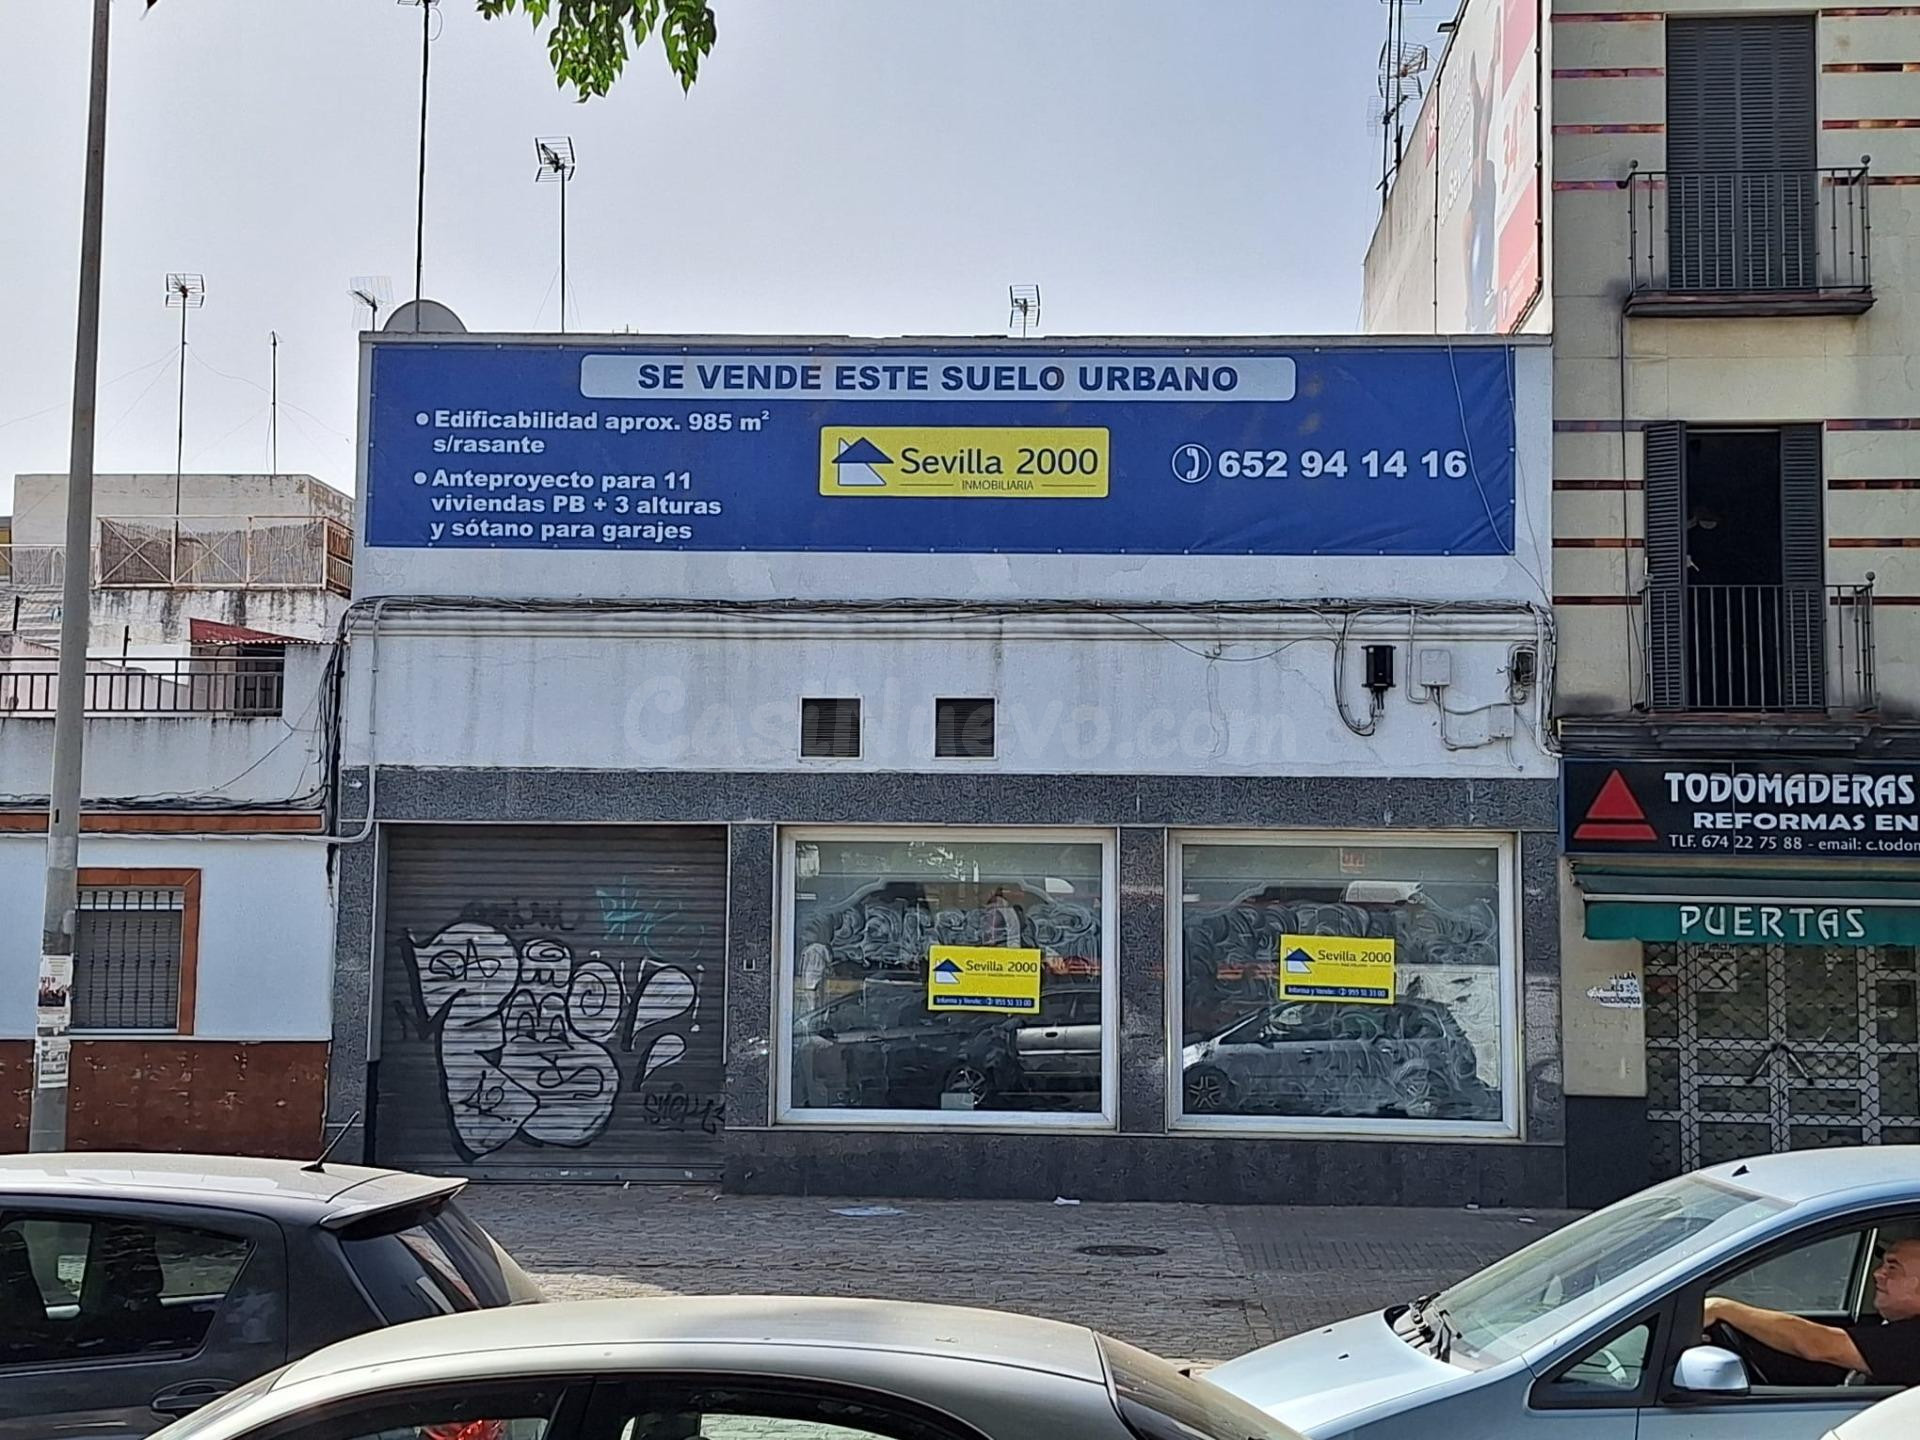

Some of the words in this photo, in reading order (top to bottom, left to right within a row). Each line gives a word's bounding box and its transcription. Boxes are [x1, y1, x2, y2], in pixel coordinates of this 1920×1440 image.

[638, 364, 684, 390] SE
[696, 364, 822, 390] VENDE
[835, 365, 929, 391] ESTE
[940, 365, 1065, 391] SUELO
[1079, 366, 1238, 392] URBANO
[434, 410, 598, 429] Edificabilidad
[605, 416, 681, 434] aprox.
[688, 413, 732, 431] 985
[433, 434, 545, 454] s/rasante
[900, 447, 1004, 475] Sevilla
[1016, 448, 1098, 475] 2000
[1218, 450, 1288, 478] 652
[1301, 450, 1348, 478] 94
[1361, 450, 1408, 478] 14
[1421, 450, 1467, 478] 16
[431, 469, 594, 492] Anteproyecto
[601, 475, 656, 493] para
[664, 471, 690, 490] 11
[961, 479, 1034, 491] INMOBILIARIA
[431, 493, 545, 513] viviendas
[553, 495, 586, 513] PB
[593, 497, 607, 511] +
[614, 495, 629, 514] 3
[636, 496, 722, 515] alturas
[430, 522, 444, 540] y
[451, 518, 534, 537] sótano
[541, 524, 595, 542] para
[602, 521, 692, 543] garajes
[1664, 772, 1915, 808] TODOMADERAS
[1694, 812, 1866, 831] REFORMAS
[1875, 814, 1919, 831] EN
[1668, 834, 1697, 848] TLF.
[1702, 835, 1729, 848] 674
[1735, 835, 1754, 849] 22
[1760, 836, 1777, 849] 75
[1783, 836, 1803, 850] 88
[1818, 838, 1862, 851] email:
[1679, 905, 1866, 940] PUERTAS
[966, 960, 1003, 971] Sevilla
[1007, 962, 1037, 973] 2000
[1318, 950, 1356, 961] Sevilla
[1361, 952, 1391, 963] 2000
